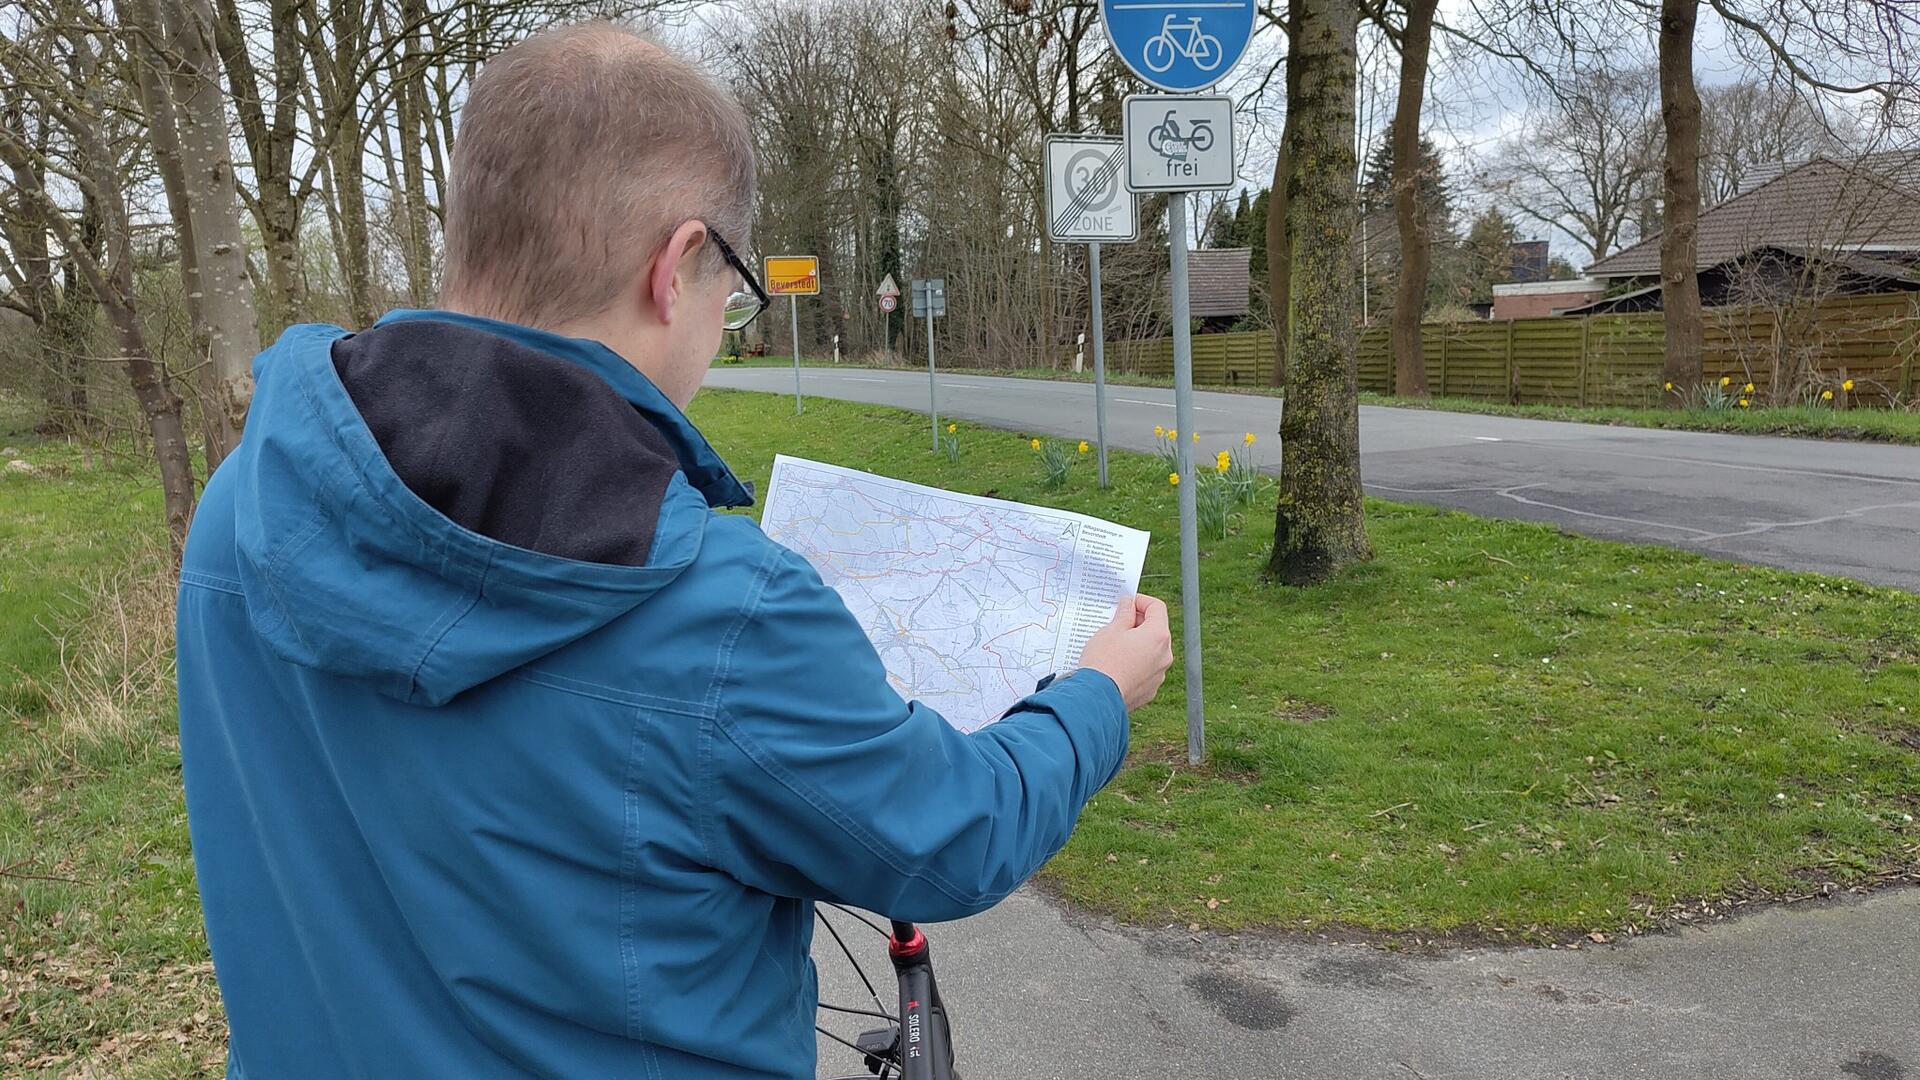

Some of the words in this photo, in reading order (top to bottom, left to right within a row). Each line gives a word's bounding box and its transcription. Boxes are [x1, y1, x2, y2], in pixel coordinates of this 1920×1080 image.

[1166, 158, 1199, 177] frei
[1073, 216, 1113, 231] ZONE
[770, 279, 815, 289] Beverstedt
[908, 1014, 921, 1043] SOLERO
